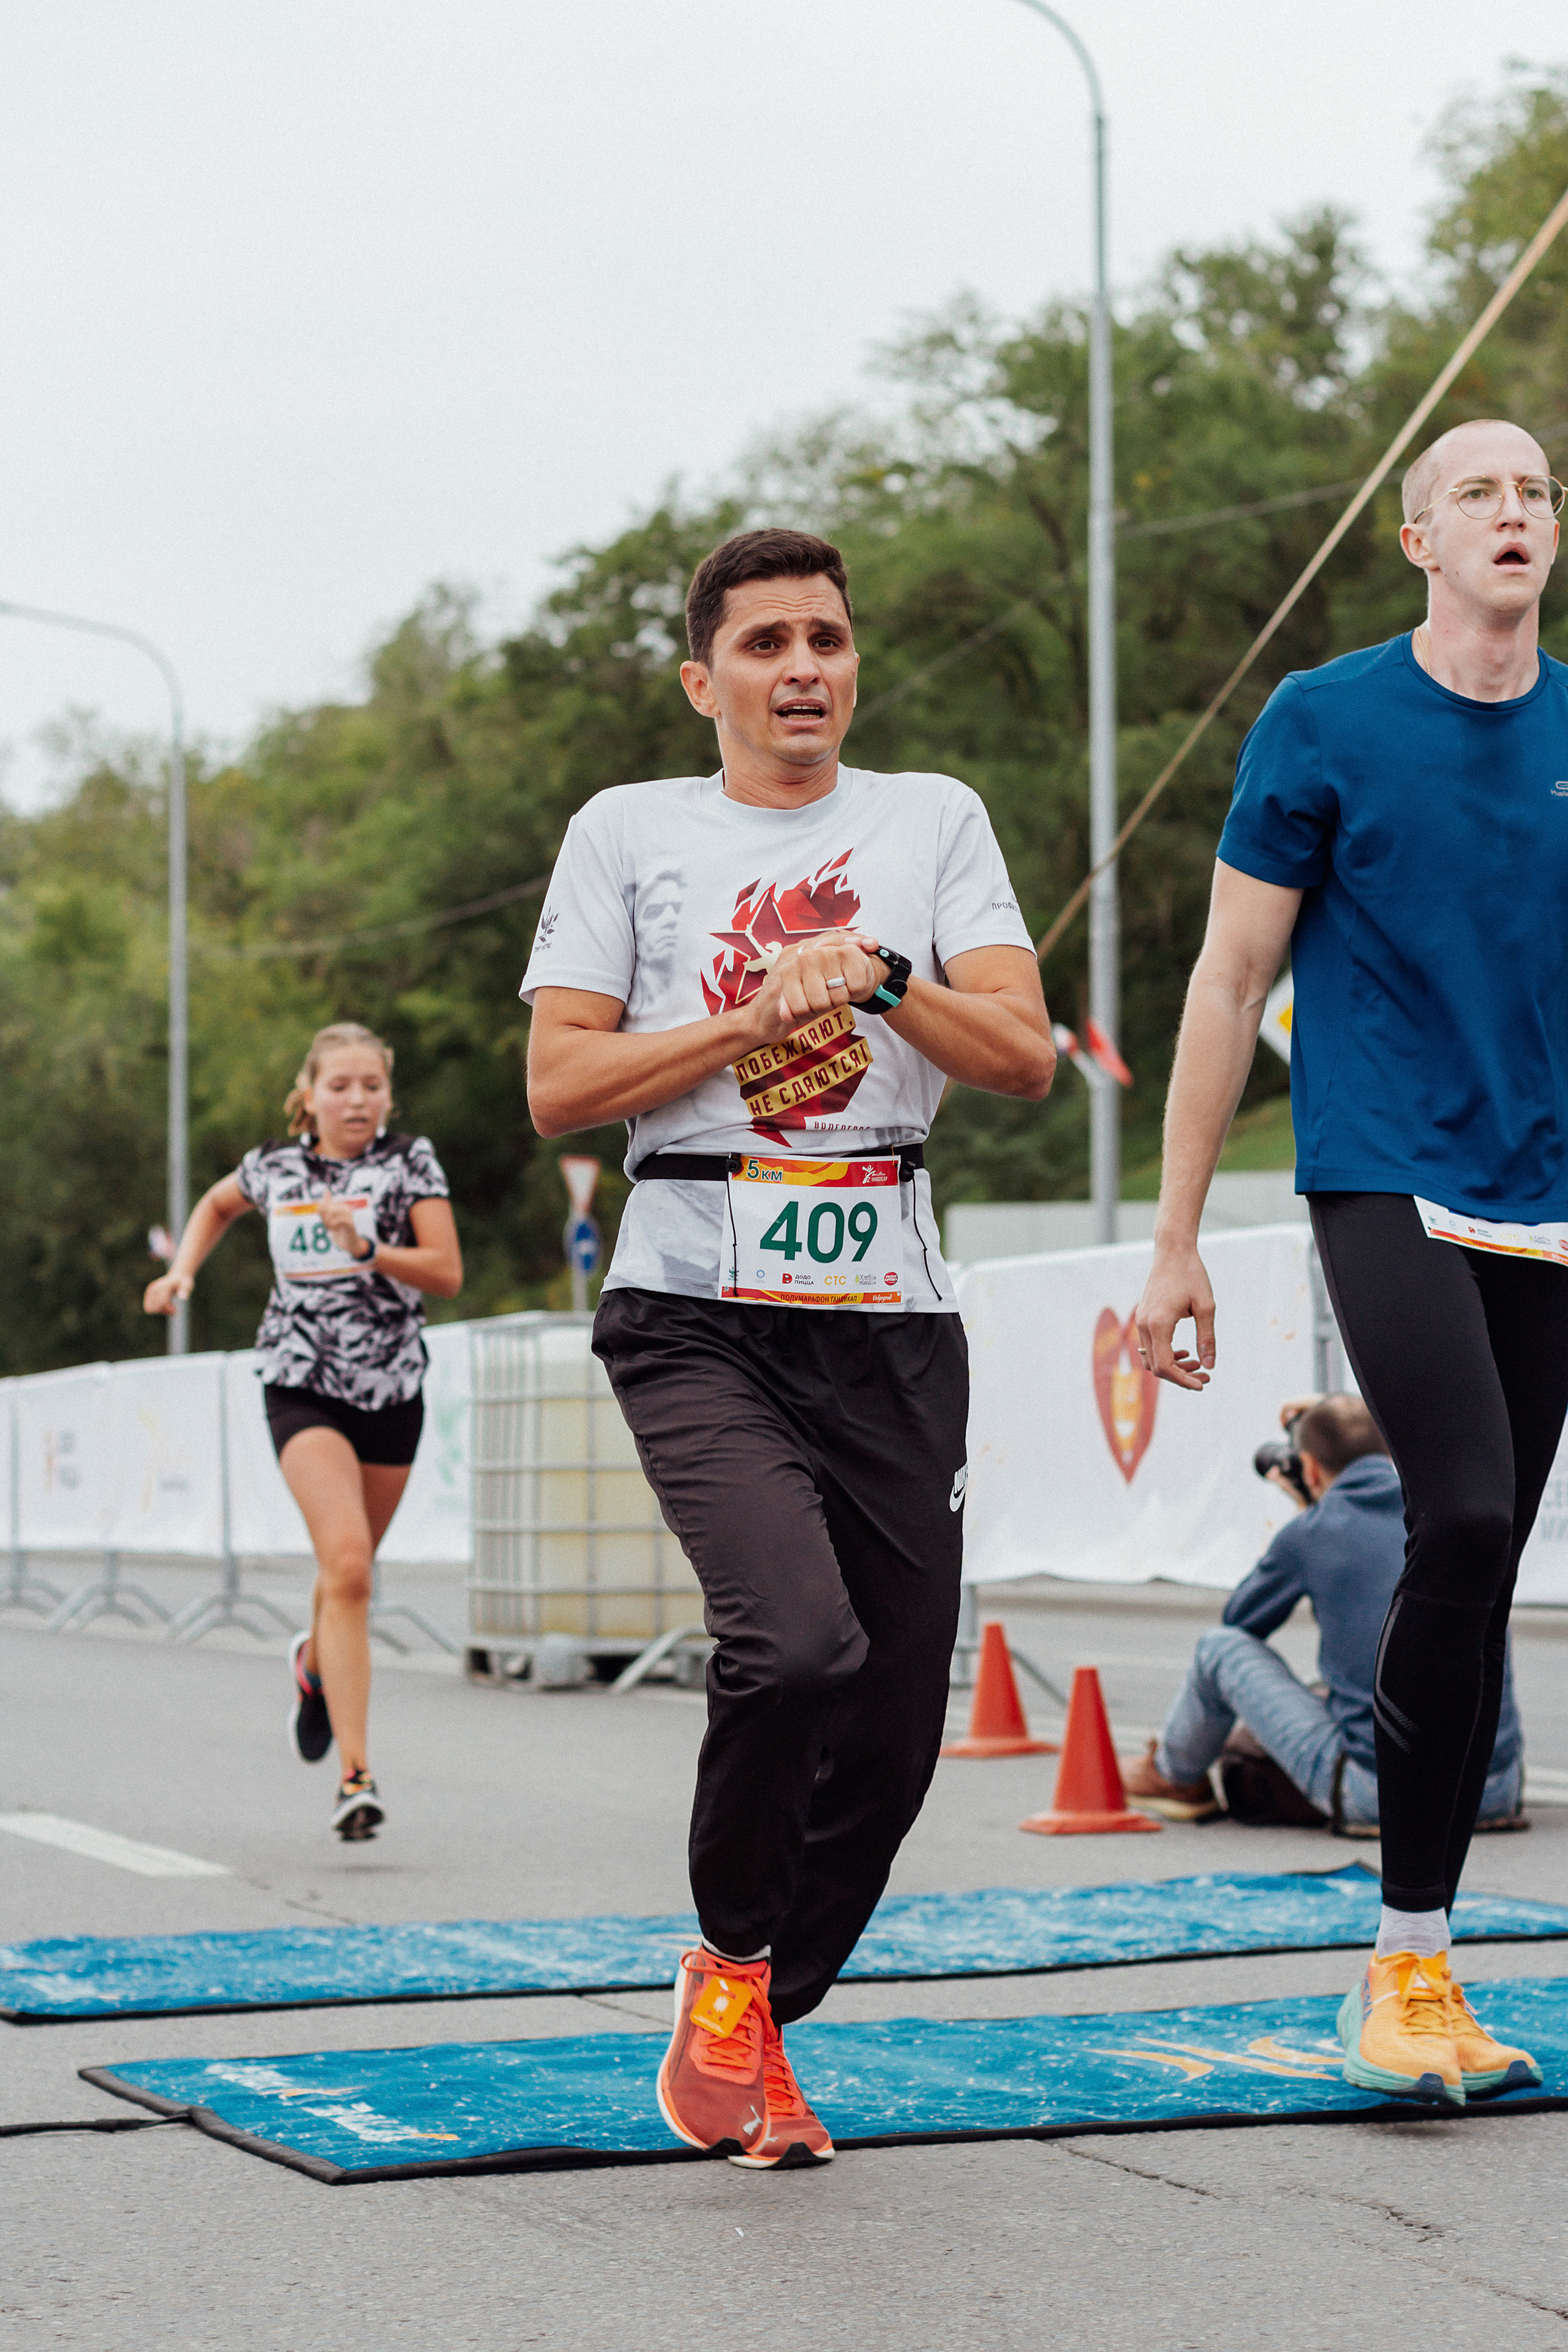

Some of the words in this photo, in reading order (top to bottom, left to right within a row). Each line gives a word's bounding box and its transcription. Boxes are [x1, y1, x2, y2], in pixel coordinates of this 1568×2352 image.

[750, 1094, 774, 1115] НЕ
[747, 1159, 760, 1179] 5
[289, 1223, 341, 1254] 48
[760, 1200, 878, 1264] 409
[824, 1276, 846, 1285] СТС
[780, 1294, 829, 1303] ПОЛУМАРАФОН
